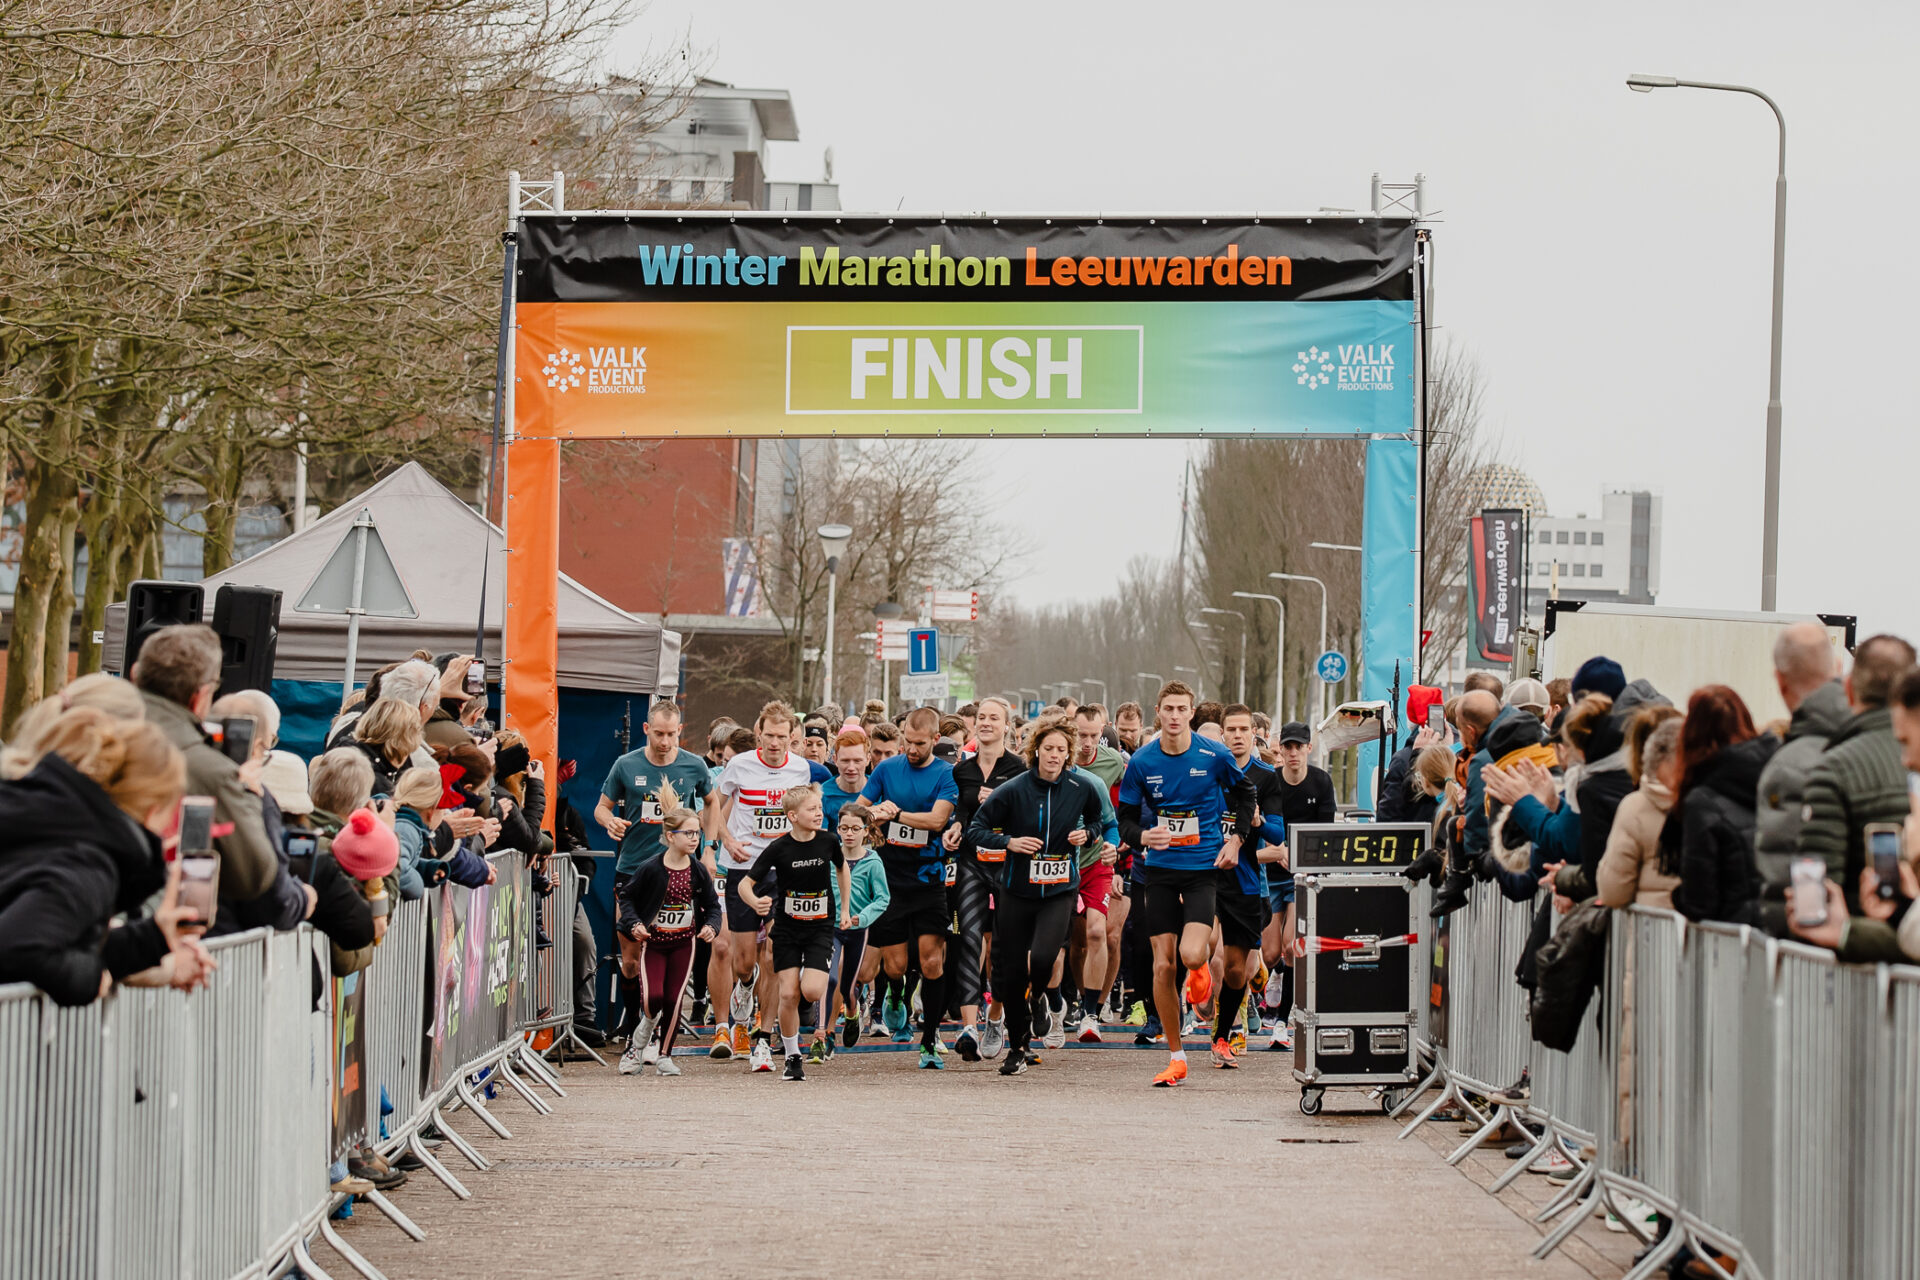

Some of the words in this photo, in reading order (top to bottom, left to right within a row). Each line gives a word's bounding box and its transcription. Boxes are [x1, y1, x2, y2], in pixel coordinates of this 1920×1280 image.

[638, 243, 786, 287] Winter
[800, 244, 1012, 287] Marathon
[1025, 244, 1293, 287] Leeuwarden
[588, 347, 647, 368] VALK
[1337, 345, 1395, 365] VALK
[850, 337, 1083, 400] FINISH
[1337, 365, 1395, 383] EVENT
[588, 369, 647, 386] EVENT
[588, 386, 646, 394] PRODUCTIONS
[1337, 383, 1395, 391] PRODUCTIONS
[757, 817, 788, 830] 1031
[1168, 819, 1185, 833] 57
[899, 825, 916, 839] 61
[792, 859, 817, 869] CRAFT
[1033, 861, 1067, 876] 1033
[946, 866, 955, 878] 2
[792, 899, 820, 913] 506
[657, 912, 686, 925] 507
